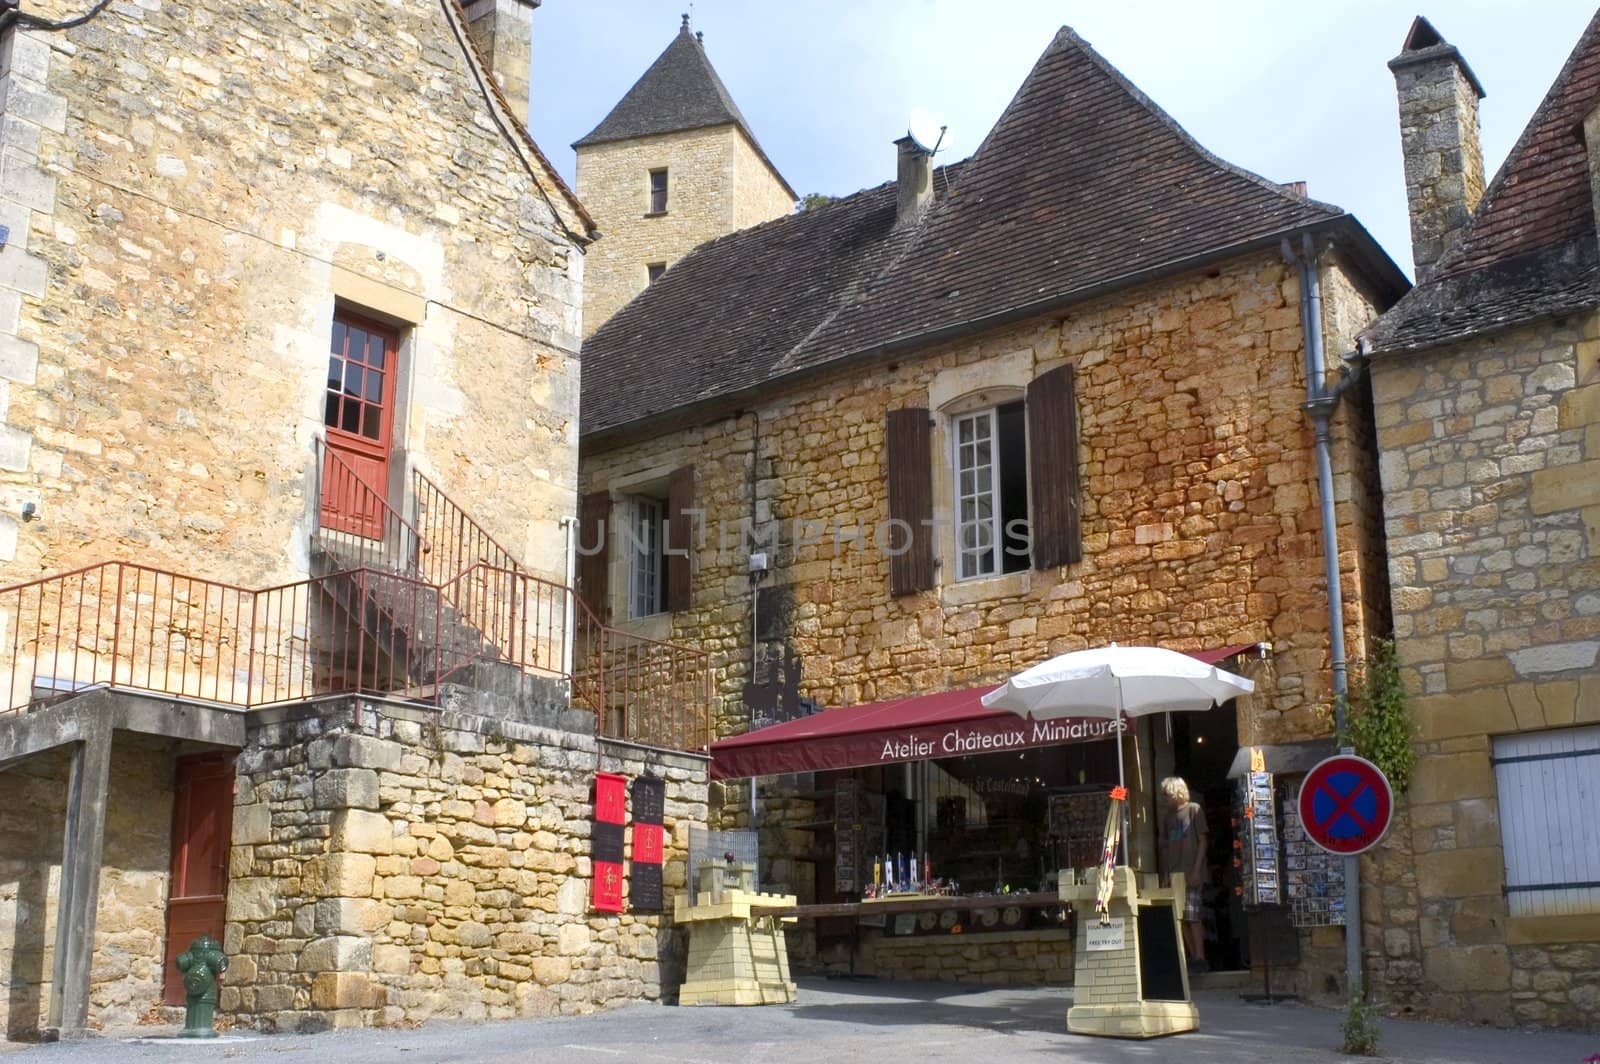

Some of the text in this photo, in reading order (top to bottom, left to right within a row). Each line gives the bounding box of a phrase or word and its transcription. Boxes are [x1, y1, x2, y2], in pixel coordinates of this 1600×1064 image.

[880, 718, 1128, 760] Atelier Châteaux Miniatures
